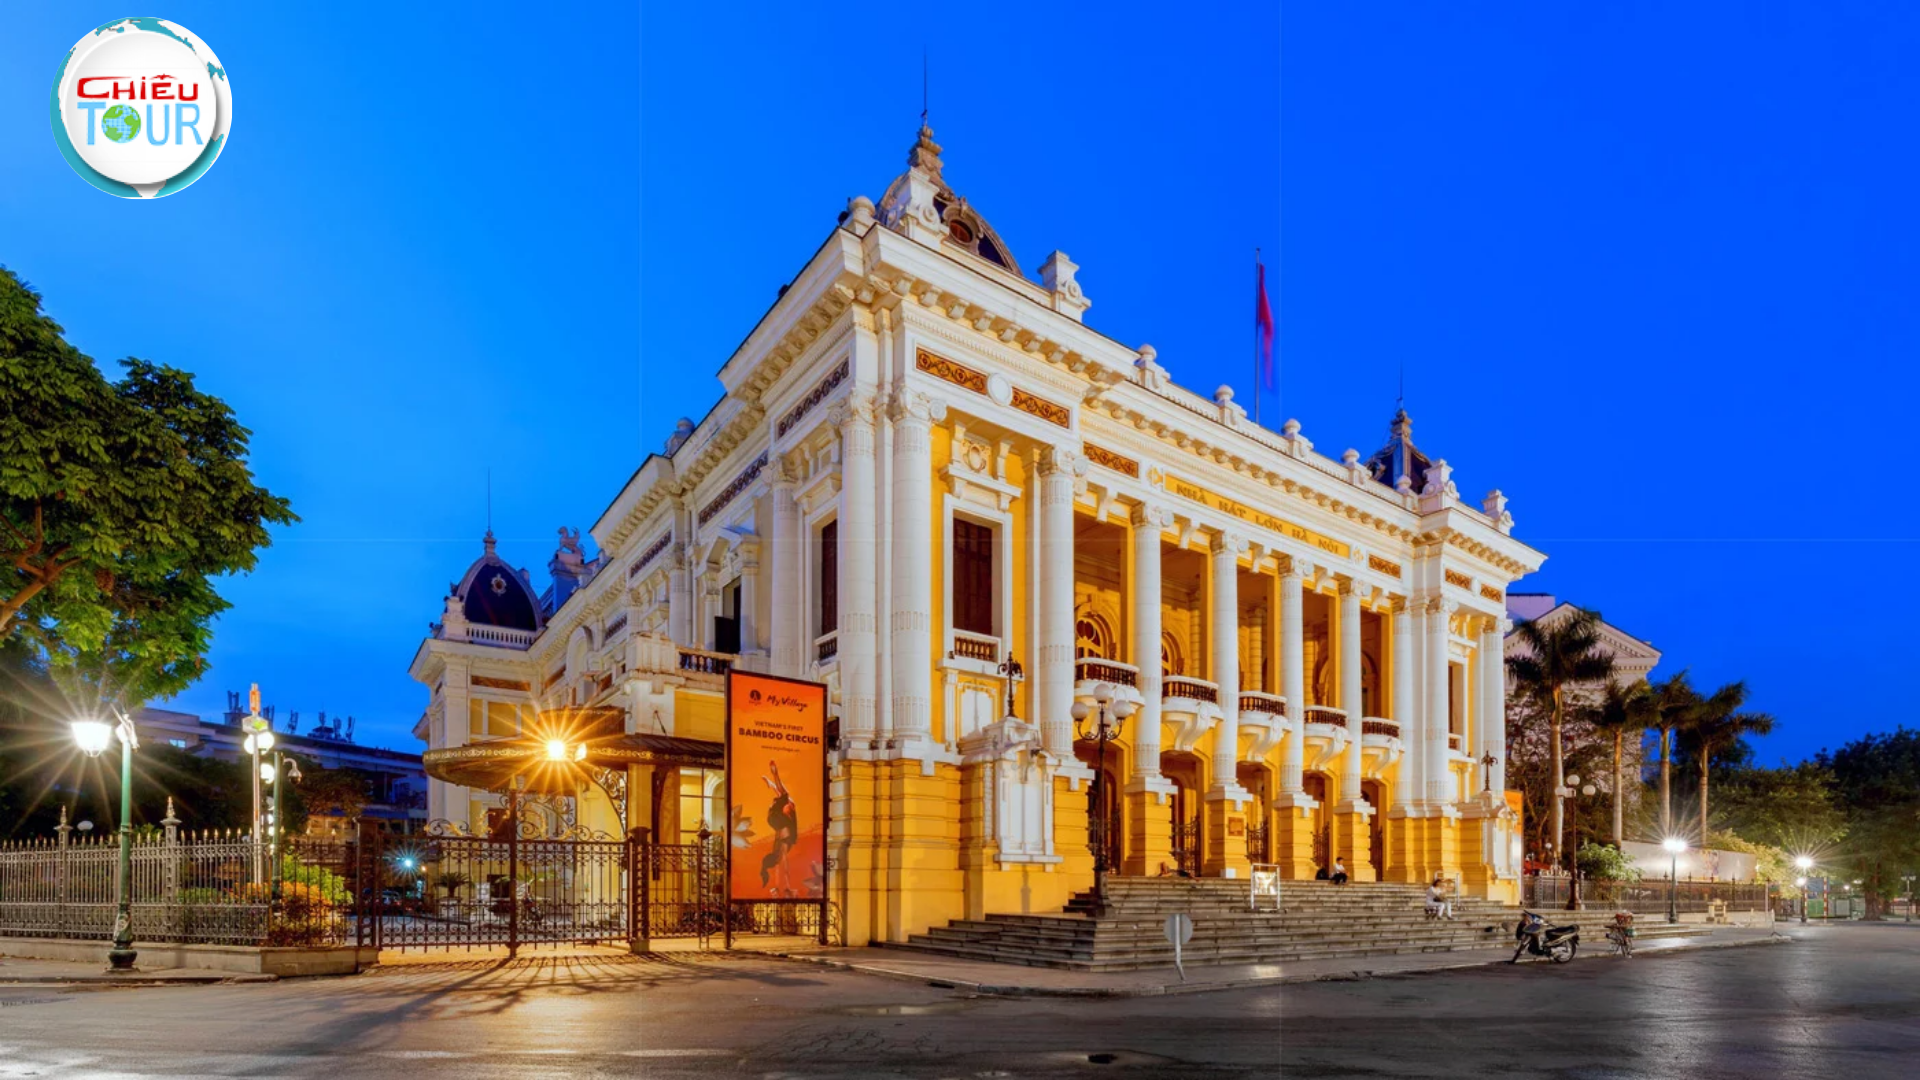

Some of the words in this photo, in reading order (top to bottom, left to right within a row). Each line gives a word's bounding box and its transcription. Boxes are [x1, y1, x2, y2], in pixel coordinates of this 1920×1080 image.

[767, 695, 780, 707] My
[781, 697, 808, 713] Village
[739, 728, 783, 740] BAMBOO
[785, 734, 819, 745] CIRCUS
